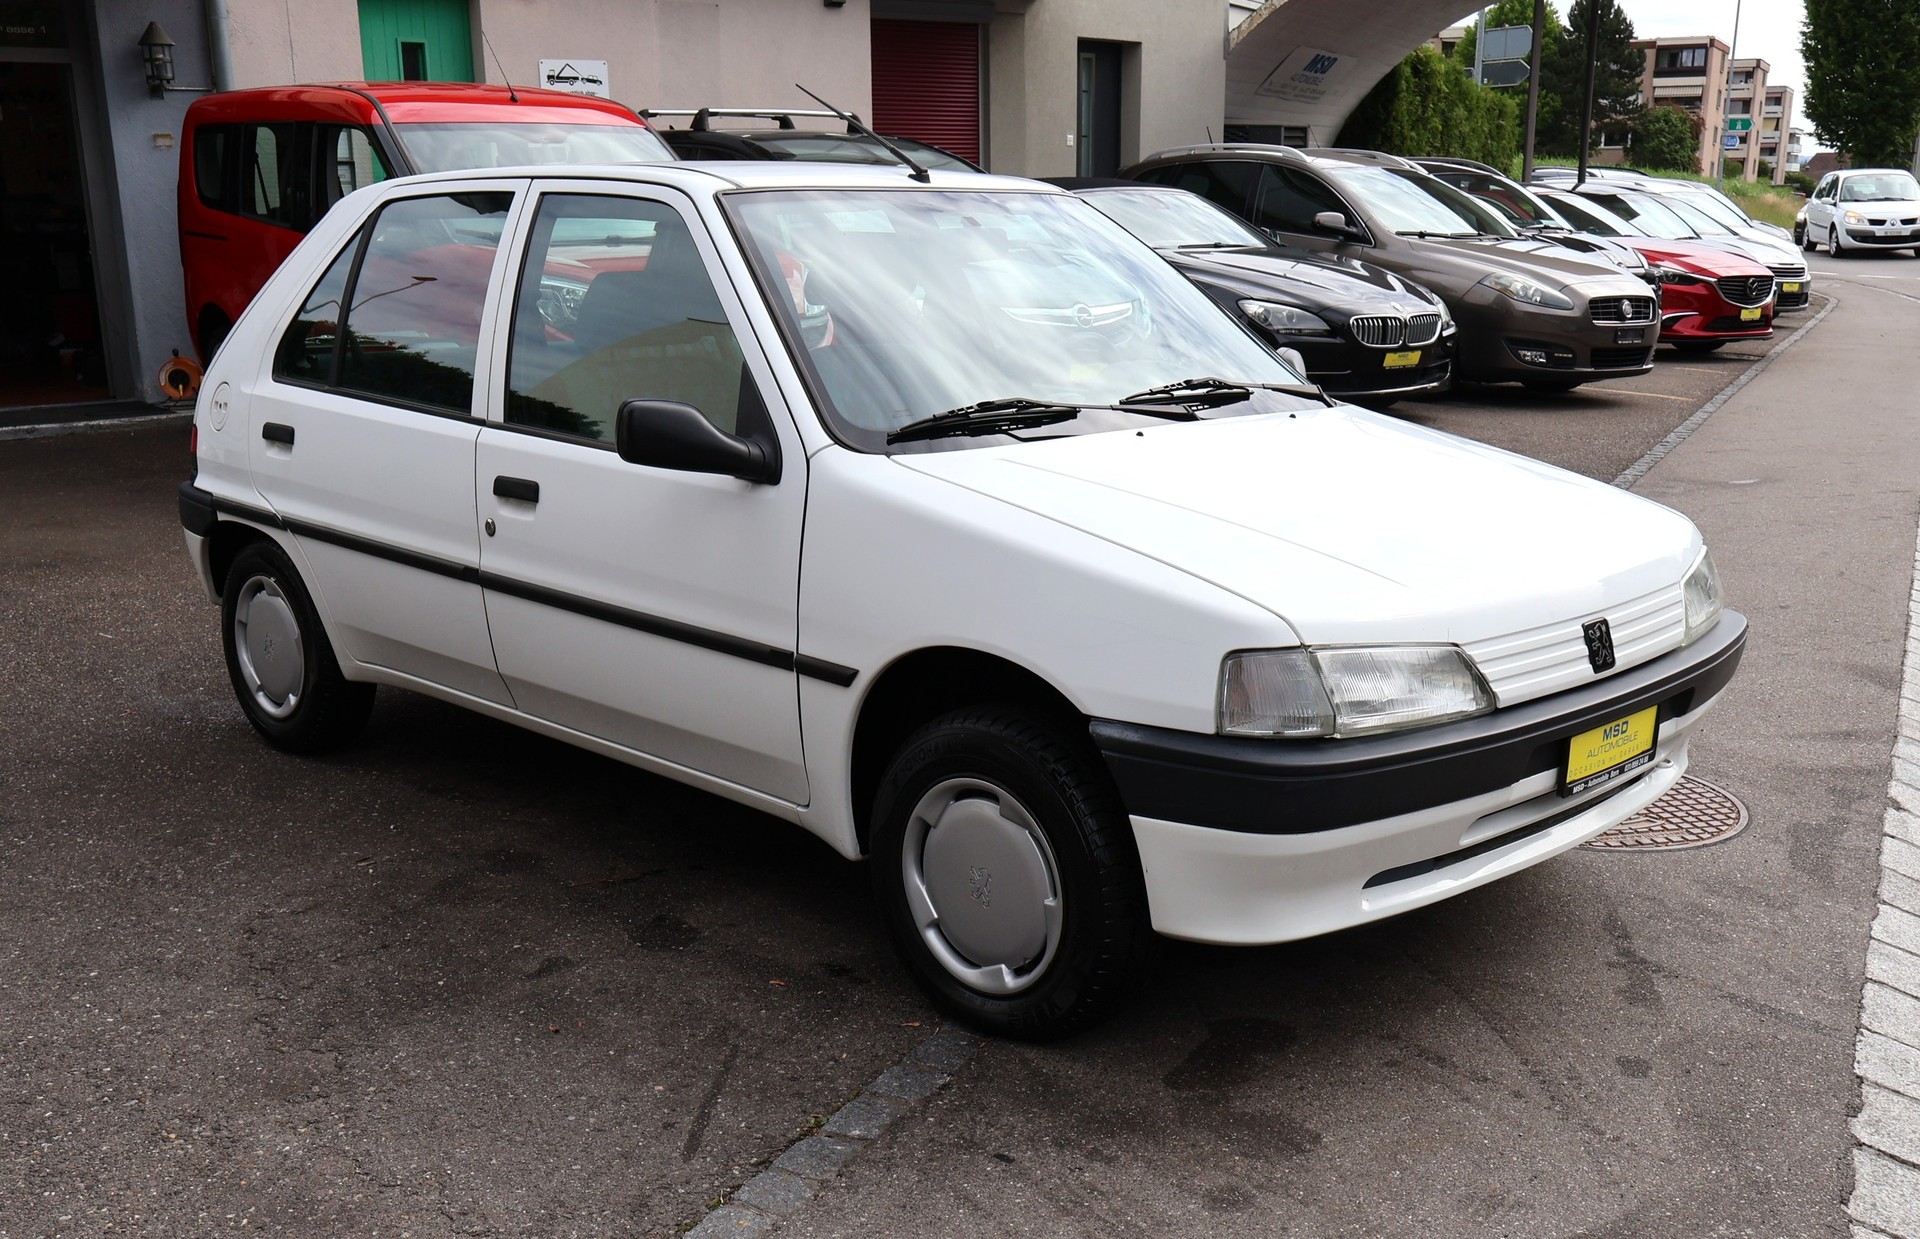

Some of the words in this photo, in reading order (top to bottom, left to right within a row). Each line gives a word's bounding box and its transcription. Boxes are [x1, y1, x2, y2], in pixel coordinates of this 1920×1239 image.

[1303, 53, 1338, 74] MSD
[1602, 720, 1629, 742] MSD
[1587, 730, 1639, 759] AUTOMOBILE
[1568, 758, 1606, 778] OCCASION
